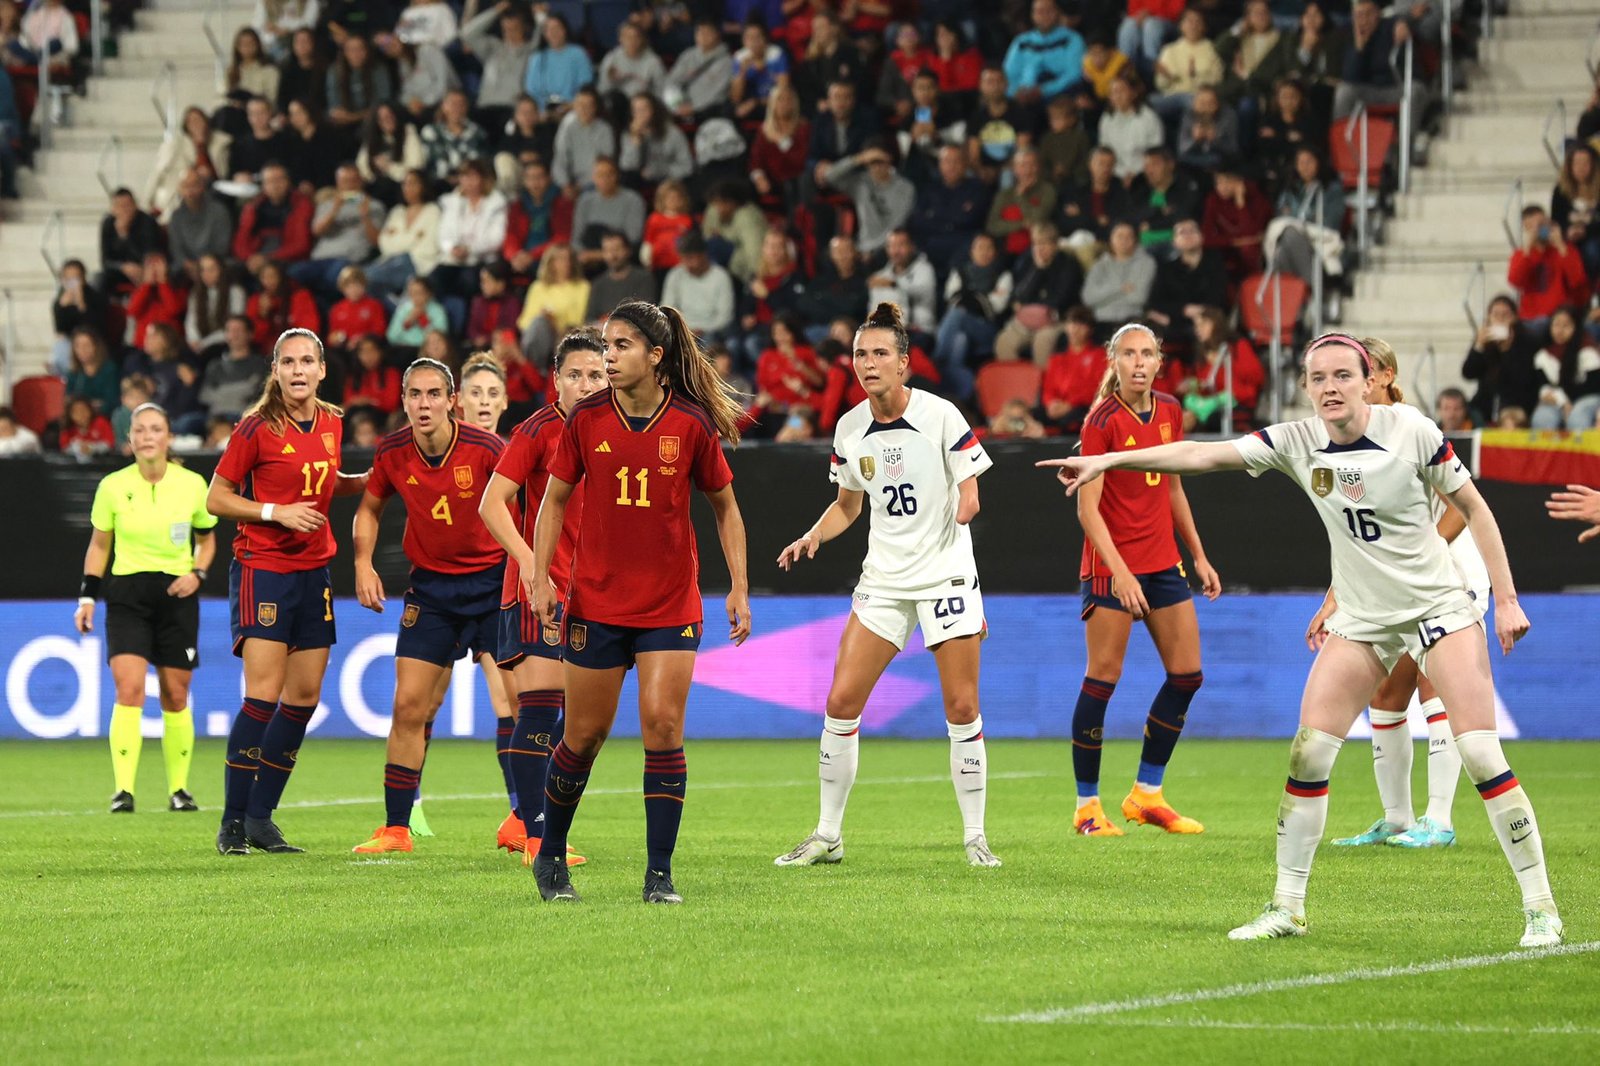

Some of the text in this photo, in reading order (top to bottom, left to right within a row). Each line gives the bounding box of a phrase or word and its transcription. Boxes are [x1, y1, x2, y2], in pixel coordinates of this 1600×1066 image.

[885, 454, 901, 464] USA
[301, 461, 329, 496] 17
[615, 466, 651, 507] 11
[1340, 473, 1361, 485] USA
[431, 495, 453, 525] 4
[882, 483, 918, 516] 26
[1343, 507, 1382, 542] 16
[964, 757, 981, 766] USA
[1510, 817, 1530, 831] USA
